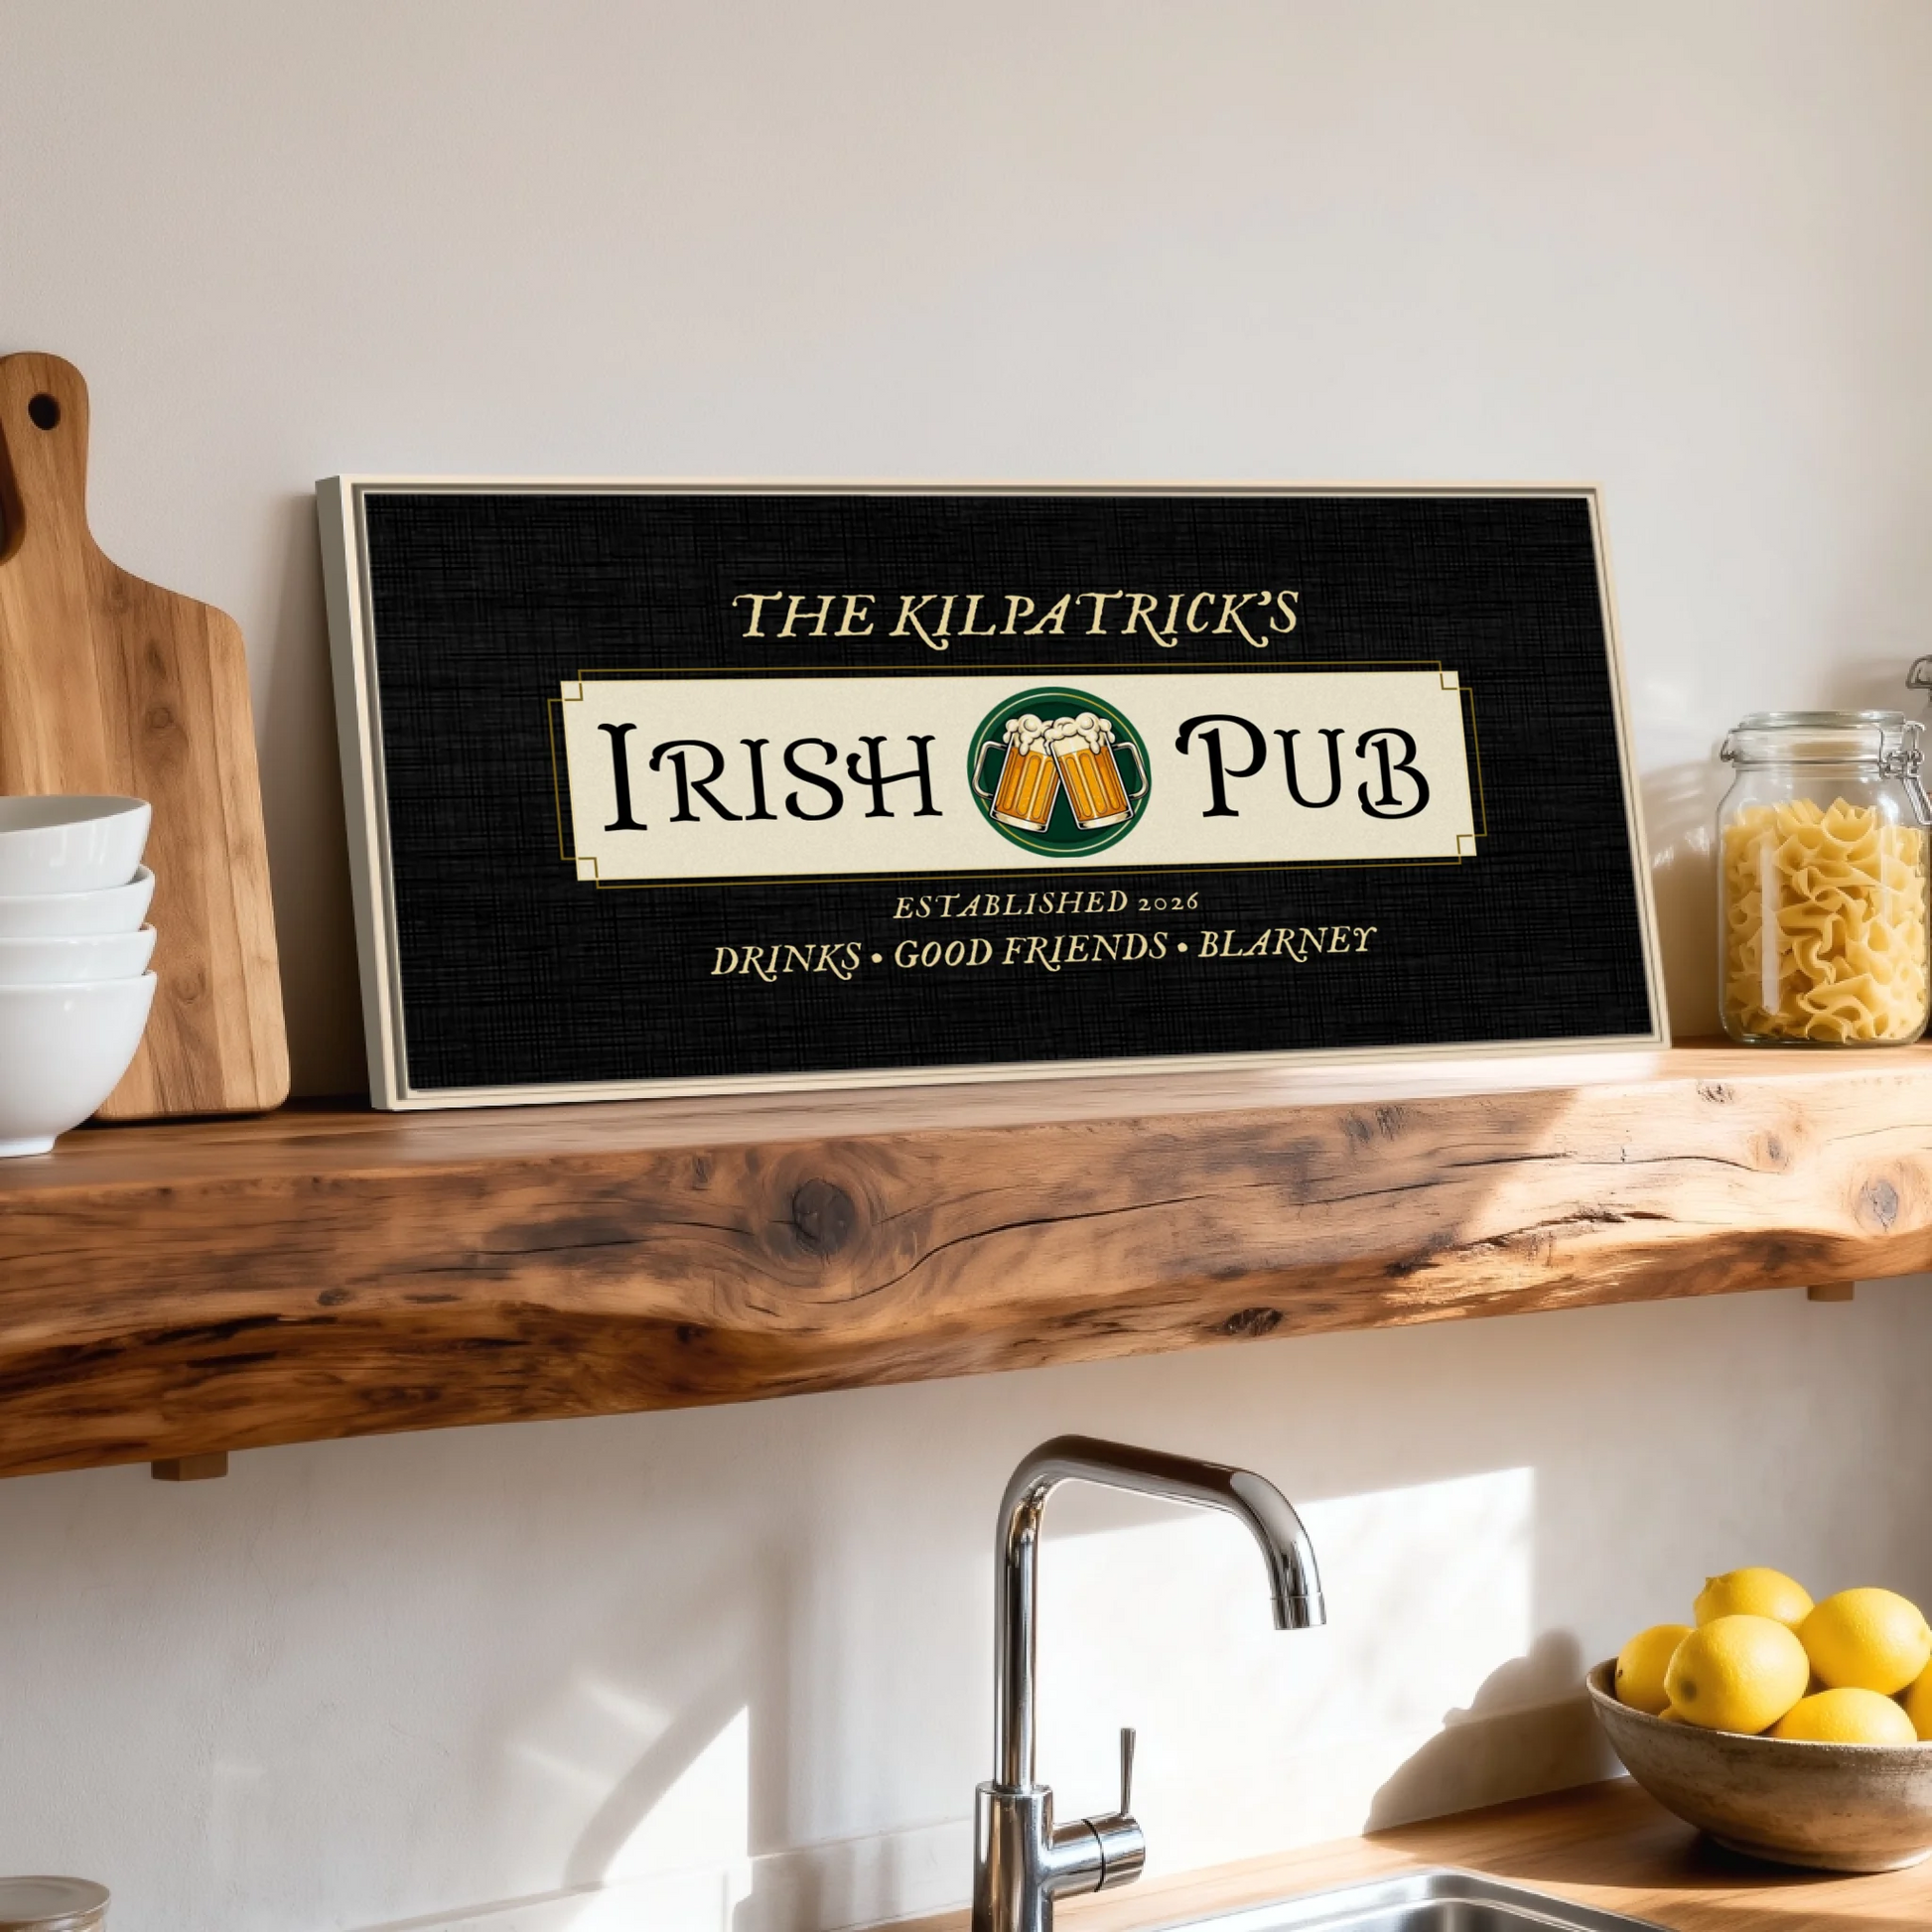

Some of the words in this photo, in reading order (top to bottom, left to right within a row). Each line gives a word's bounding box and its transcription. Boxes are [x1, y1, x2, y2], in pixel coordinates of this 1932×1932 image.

[732, 591, 876, 638] THE
[598, 723, 943, 832] IRISH
[1175, 714, 1430, 820] PUB
[893, 890, 1128, 919] ESTABLISHED
[1138, 892, 1199, 911] 2026
[710, 941, 862, 983] DRINKS
[895, 938, 993, 968] GOOD
[1002, 931, 1169, 972] FRIENDS
[1197, 925, 1378, 963] BLARNEY
